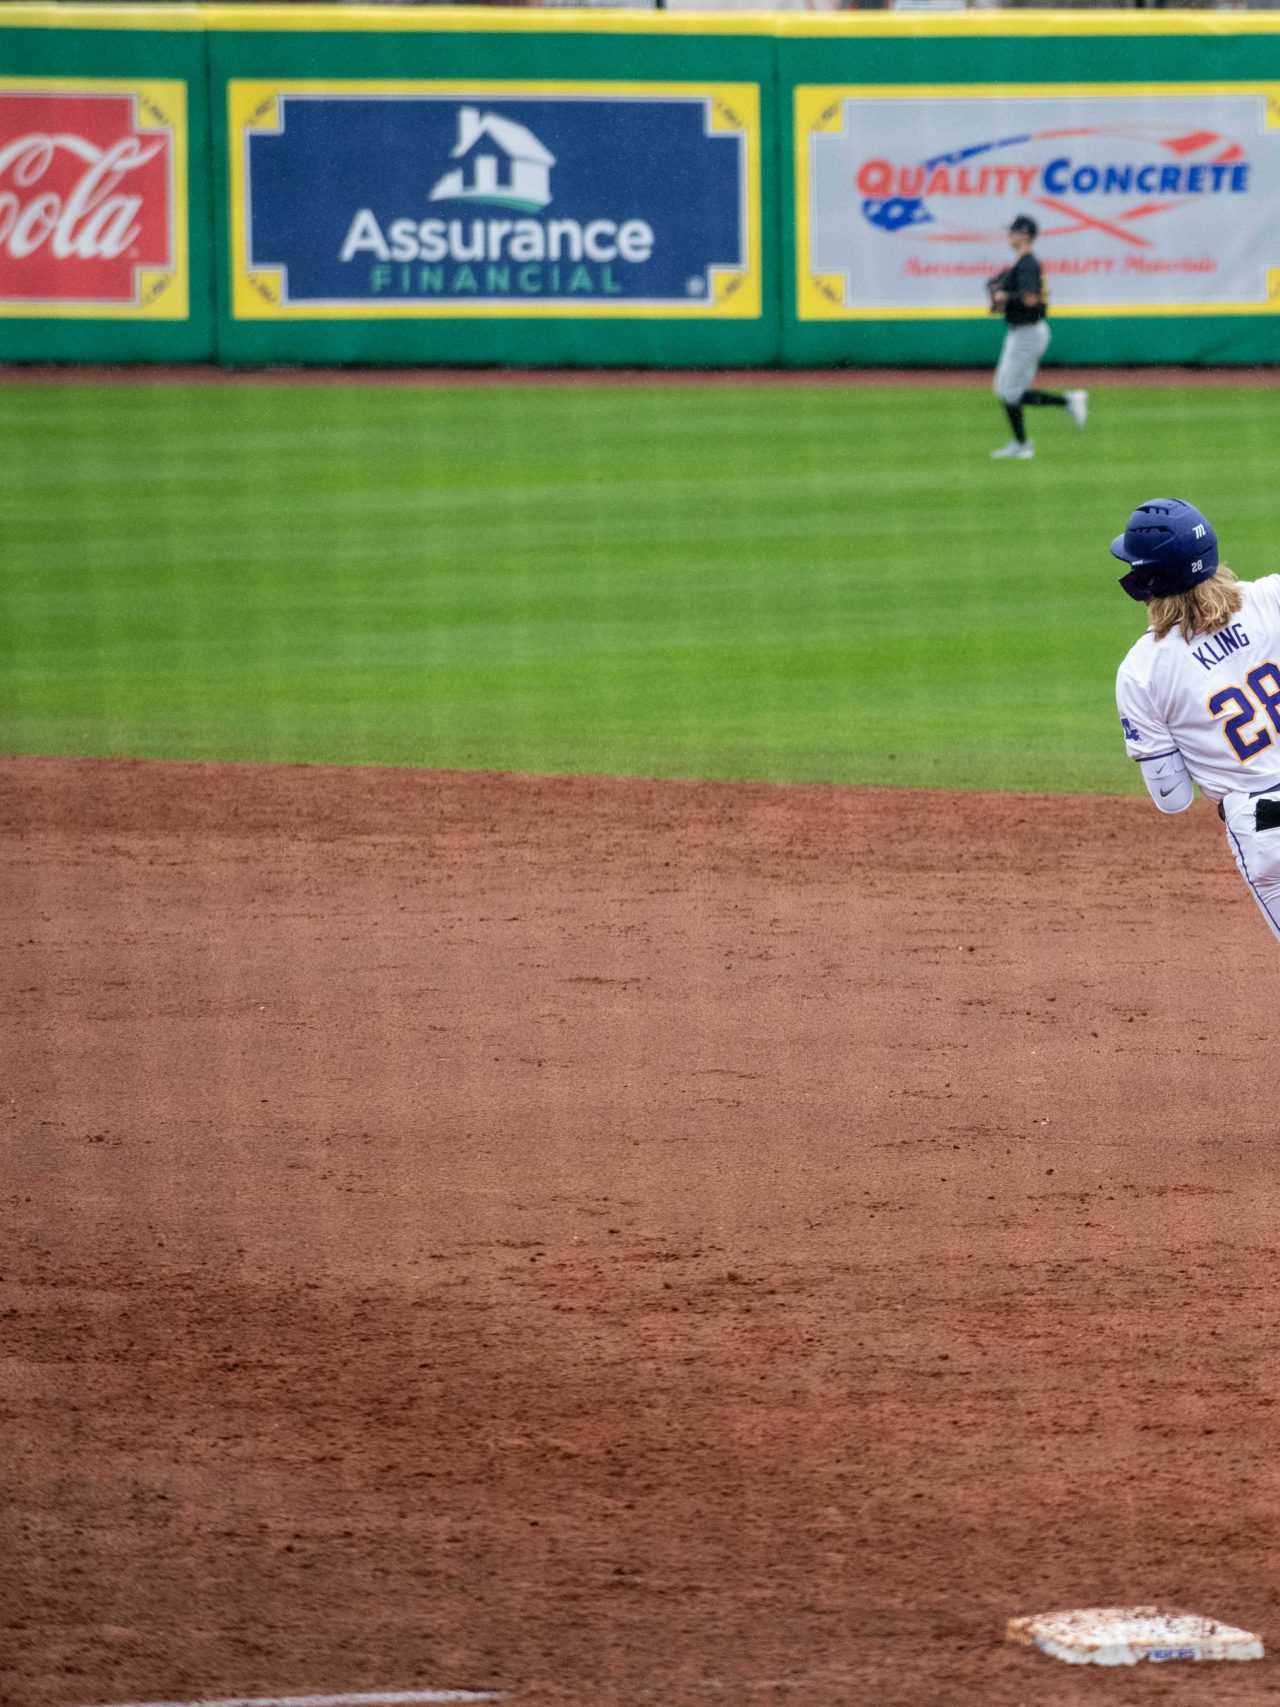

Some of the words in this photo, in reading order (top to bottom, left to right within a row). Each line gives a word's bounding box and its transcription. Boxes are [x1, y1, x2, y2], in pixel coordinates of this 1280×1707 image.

[340, 210, 654, 262] Assurance
[371, 265, 621, 293] FINANCIAL
[1191, 559, 1204, 573] 28
[1193, 624, 1250, 670] KLING
